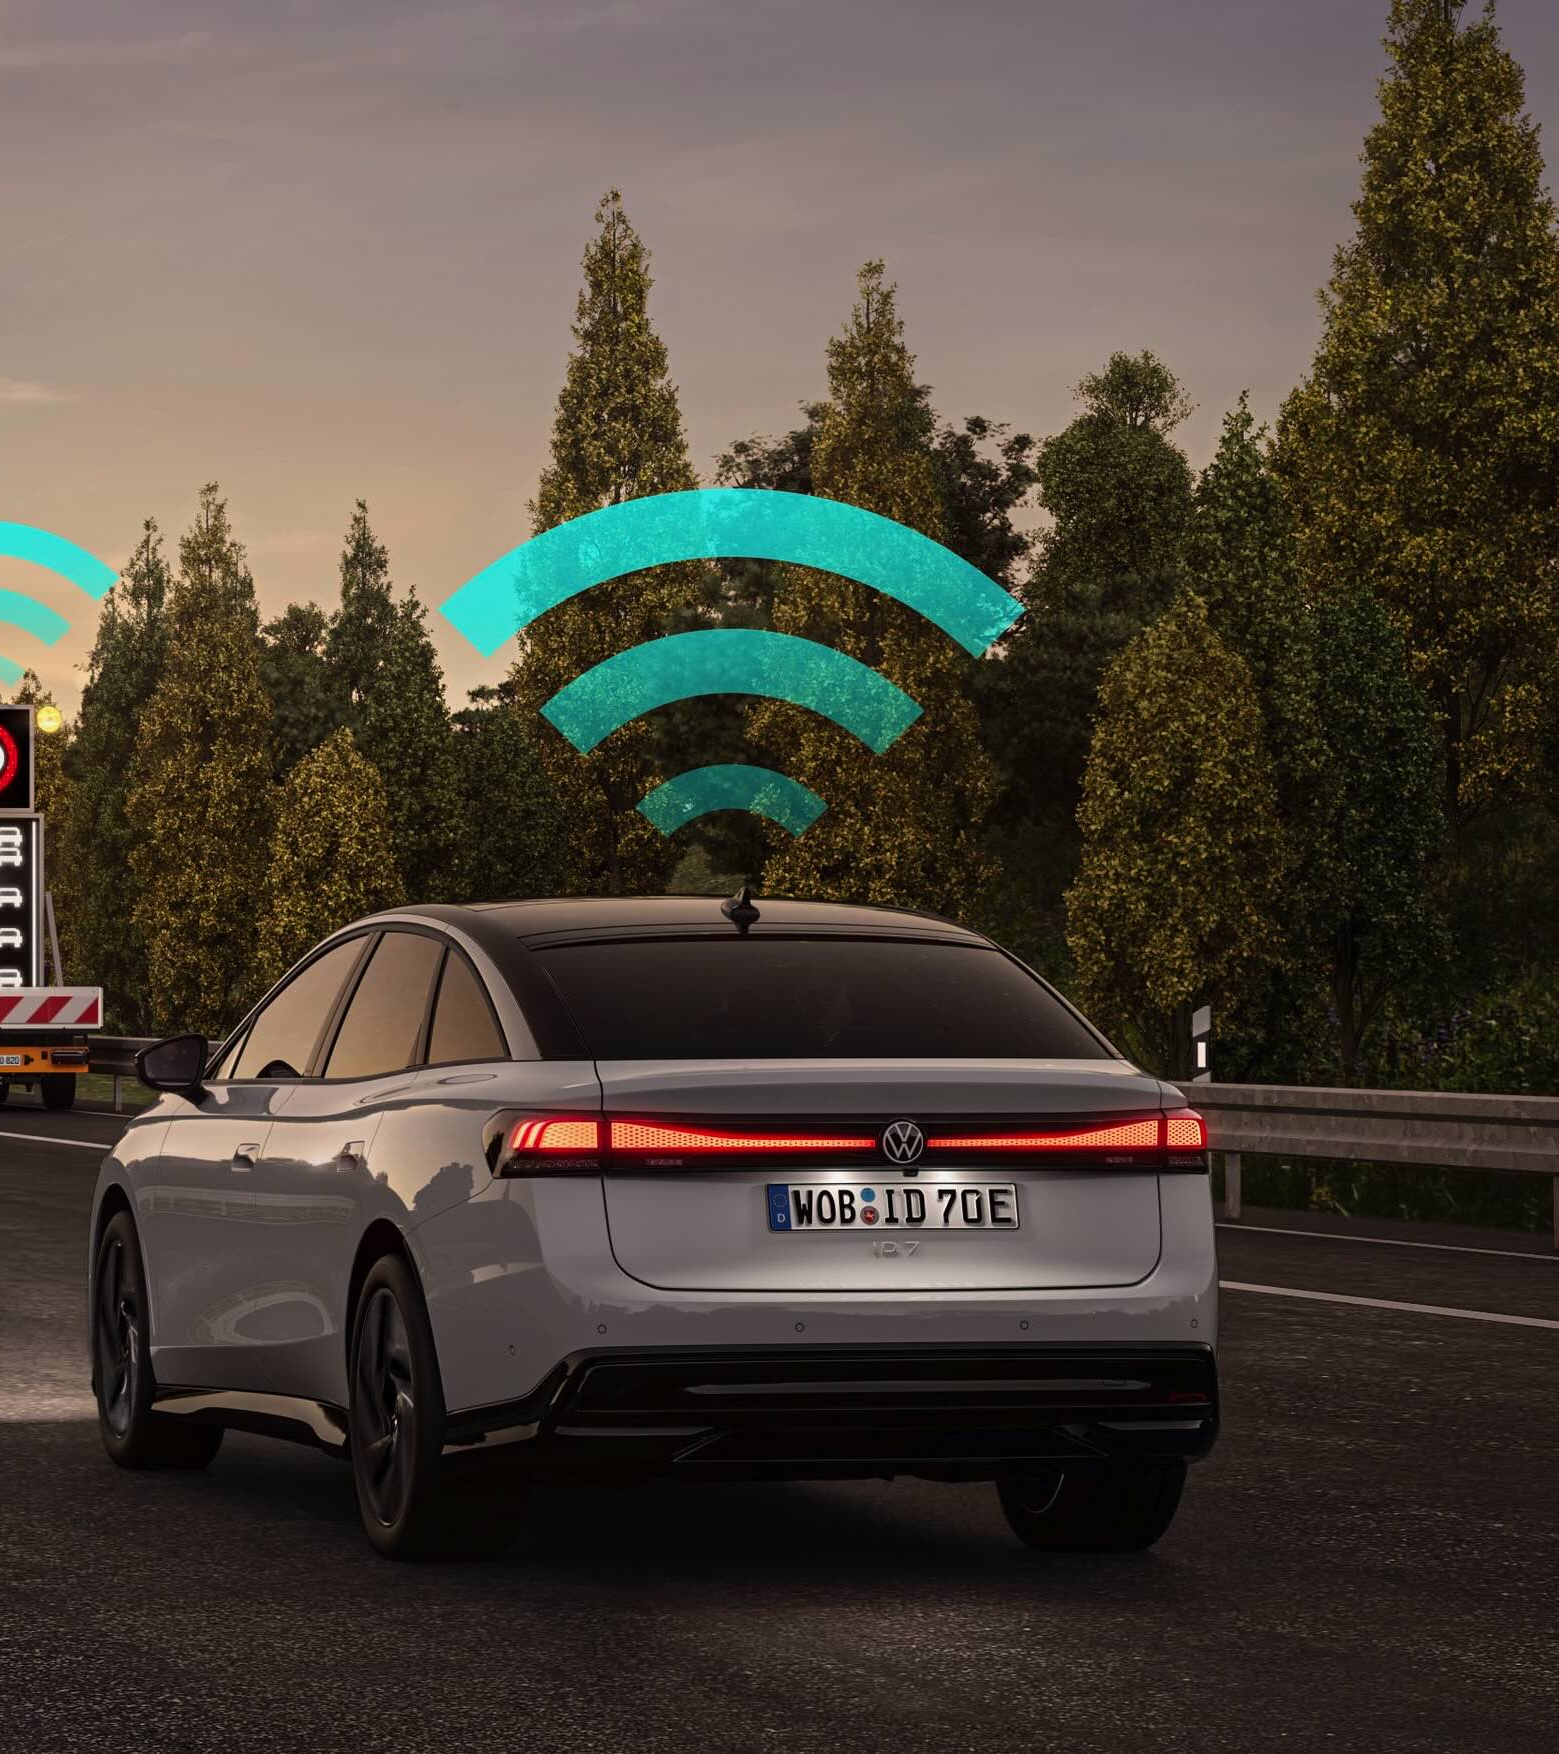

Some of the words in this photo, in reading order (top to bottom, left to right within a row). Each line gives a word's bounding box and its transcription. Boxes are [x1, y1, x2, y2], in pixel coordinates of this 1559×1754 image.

[777, 1213, 786, 1223] D
[793, 1188, 856, 1225] WOB
[884, 1188, 926, 1224] ID
[937, 1188, 1012, 1224] 70E
